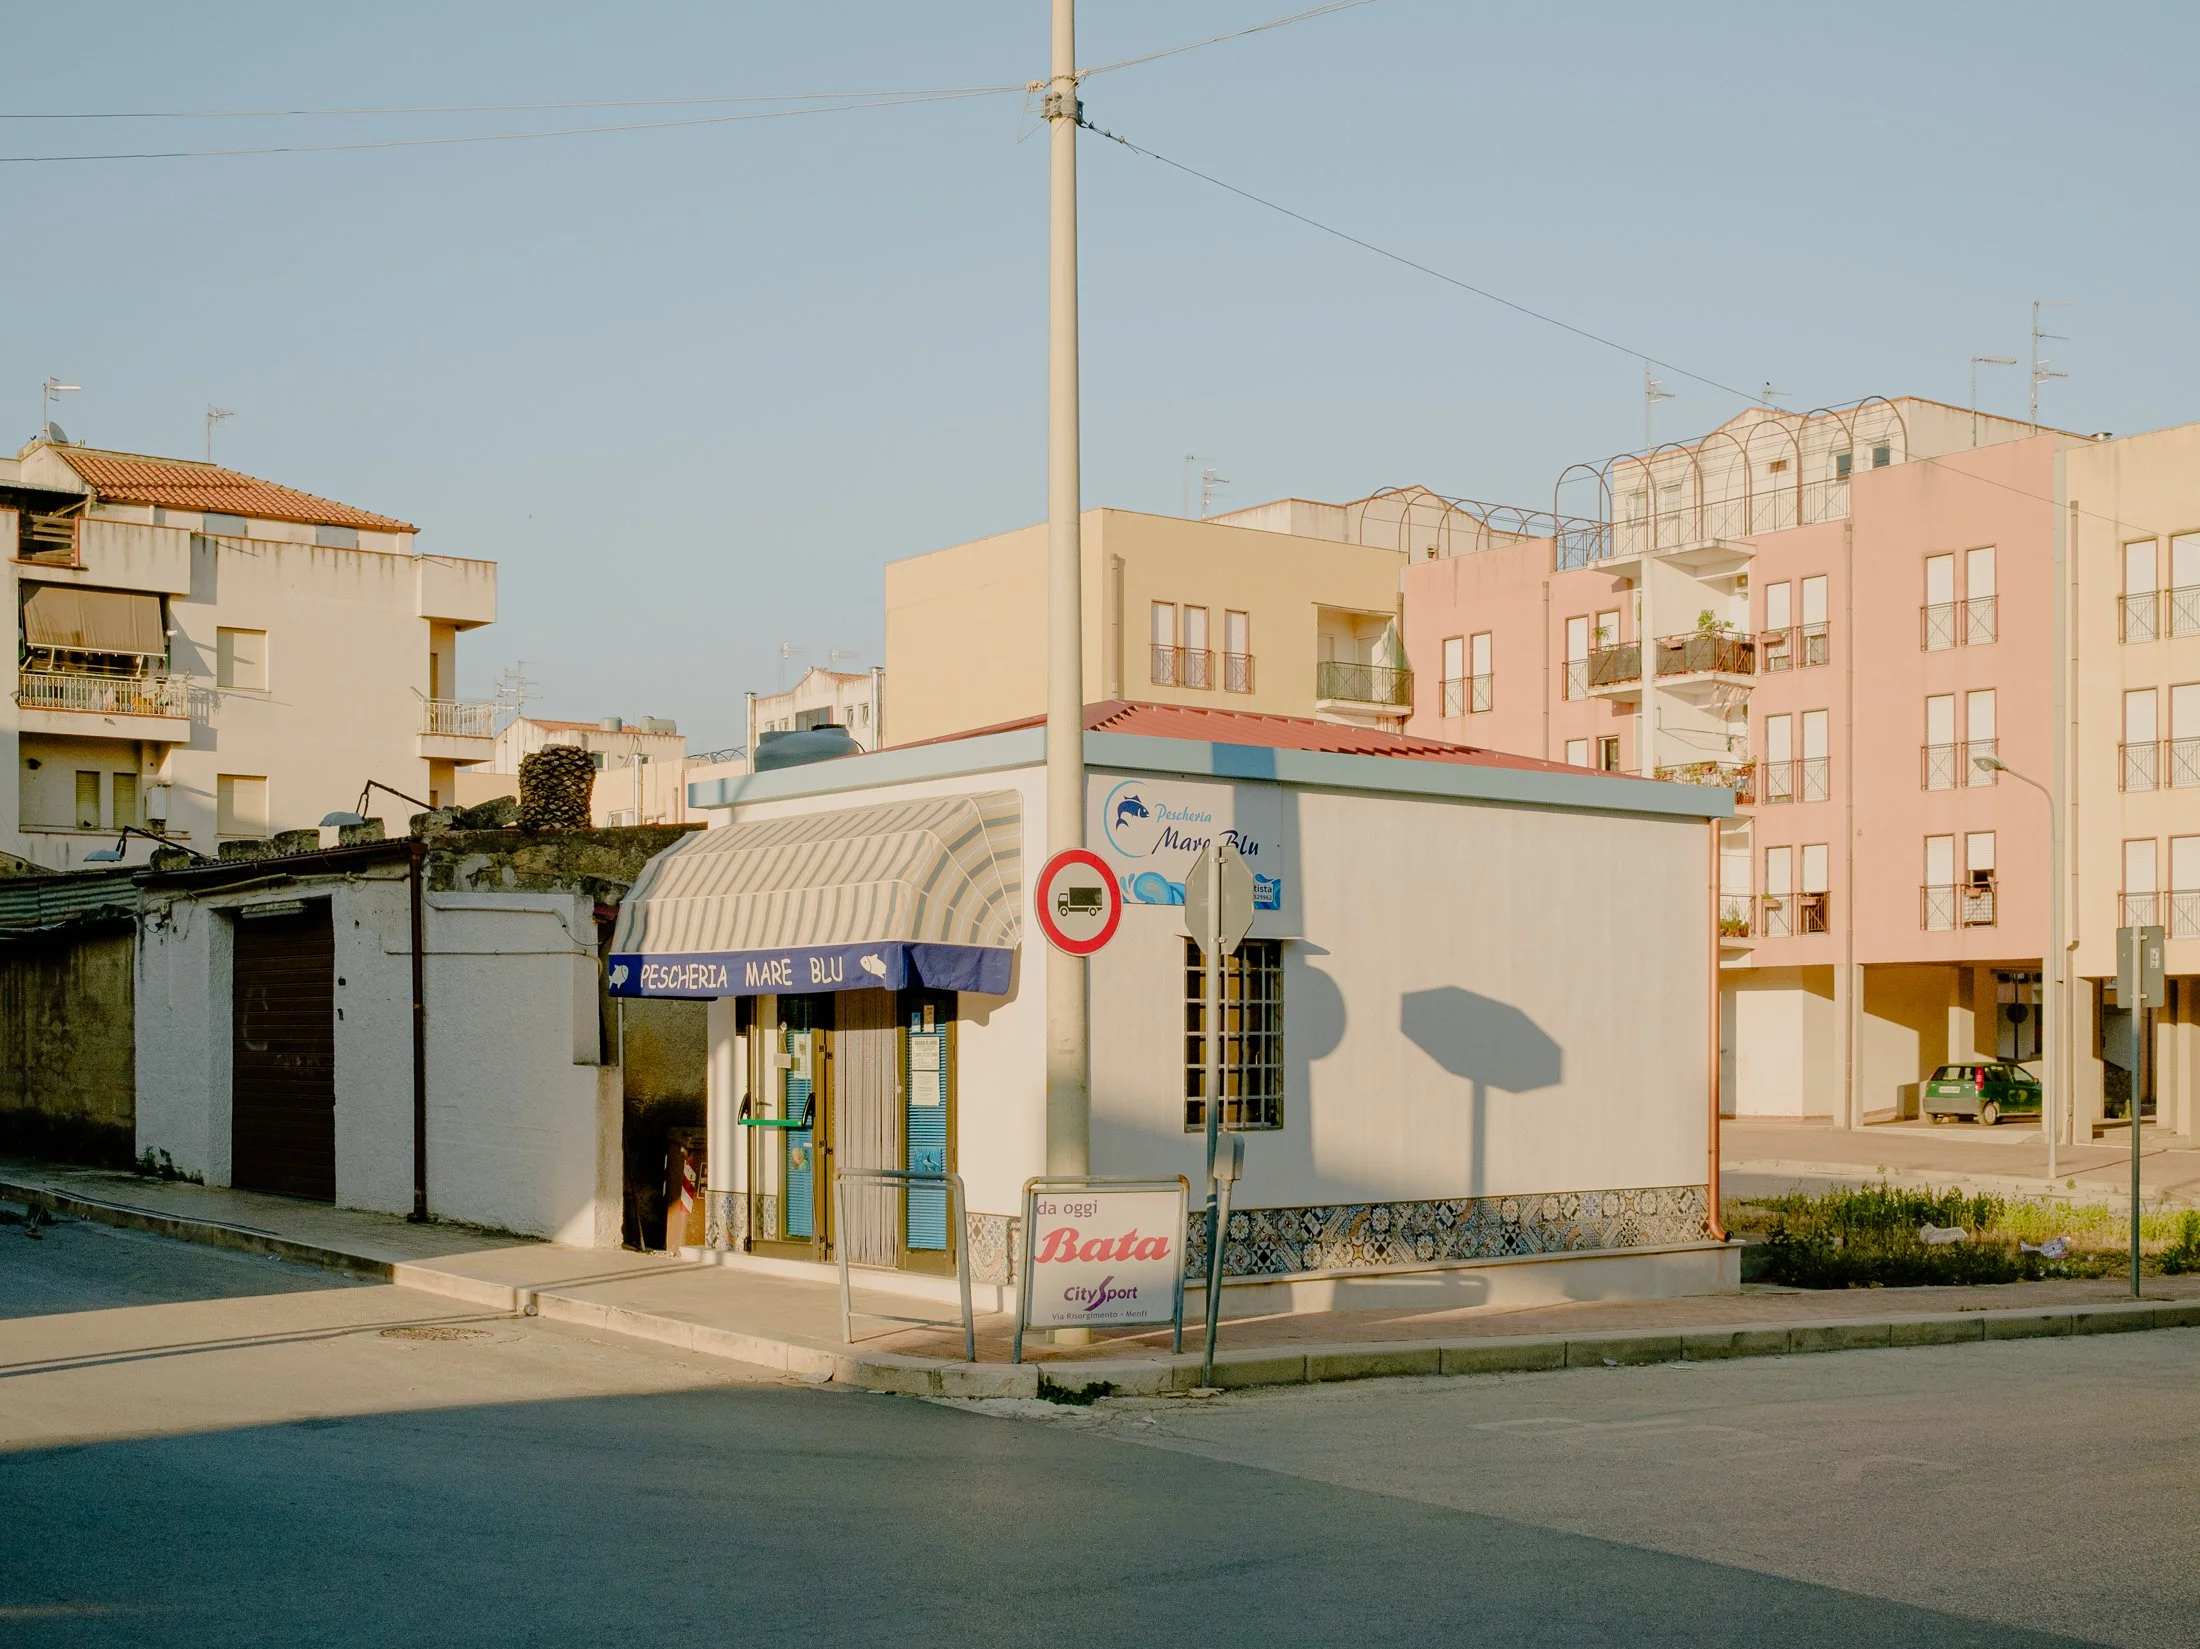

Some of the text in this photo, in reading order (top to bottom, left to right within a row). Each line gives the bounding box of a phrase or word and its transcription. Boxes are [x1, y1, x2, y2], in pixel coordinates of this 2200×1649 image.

[1154, 803, 1212, 823] Pescheria
[1218, 829, 1259, 856] Blu
[640, 956, 843, 990] PESCHERIA MARE BLU
[1037, 1200, 1098, 1218] da oggi
[1033, 1227, 1171, 1264] Bata
[1052, 1312, 1064, 1320] Via
[1066, 1311, 1118, 1321] Risorgimento
[1125, 1310, 1148, 1318] Menfi
